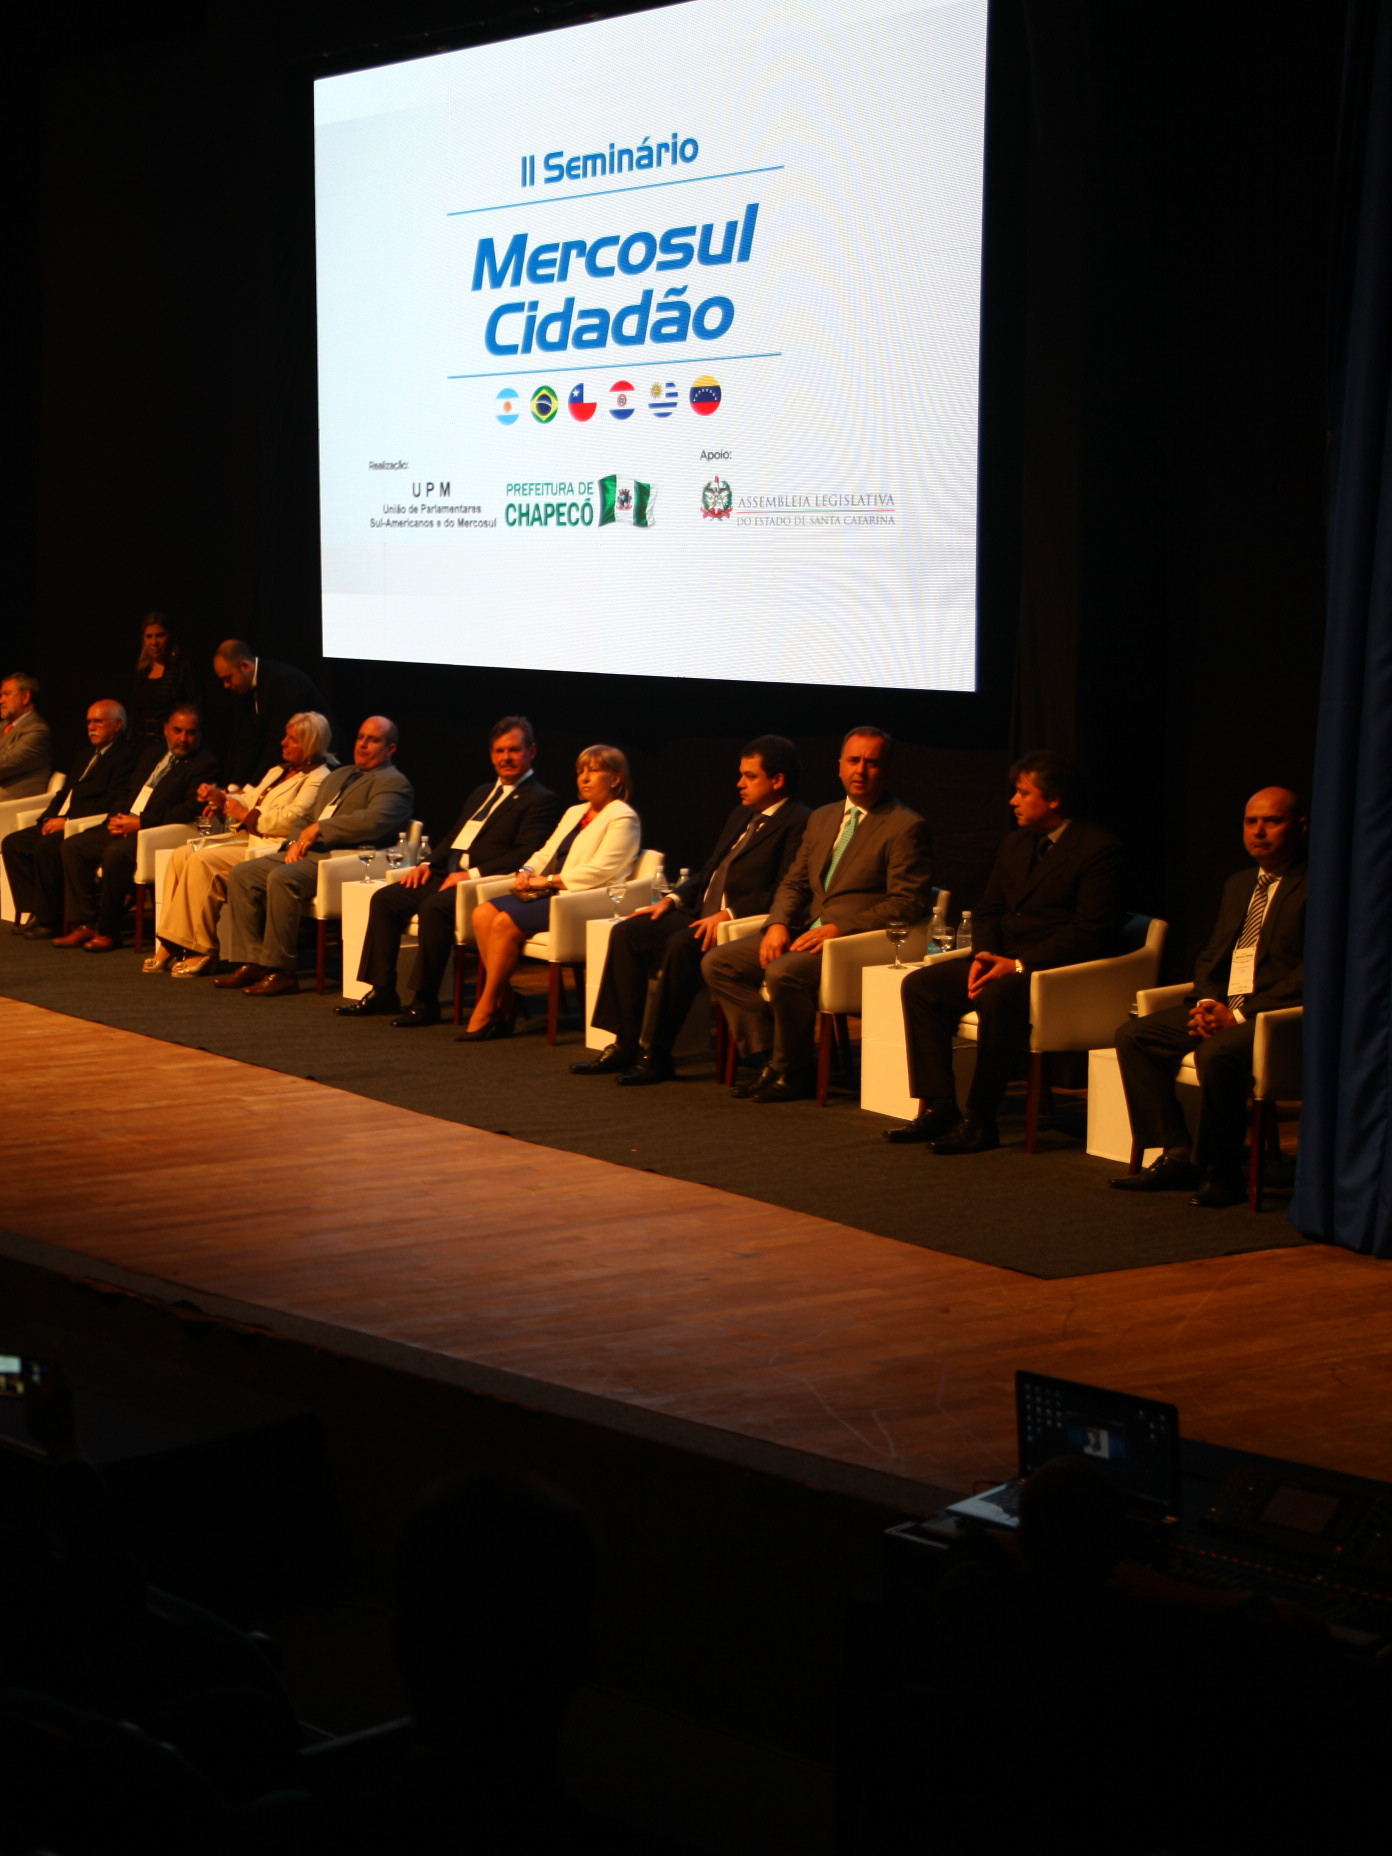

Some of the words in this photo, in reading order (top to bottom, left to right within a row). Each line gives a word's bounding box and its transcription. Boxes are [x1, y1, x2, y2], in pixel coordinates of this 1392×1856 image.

[521, 156, 535, 188] II
[544, 131, 699, 185] Seminário
[470, 203, 760, 292] Mercosul
[484, 284, 735, 357] Cidadão
[699, 449, 732, 462] Apoio:
[506, 482, 575, 497] PREFEITURA
[578, 481, 594, 496] DE
[738, 495, 811, 508] ASSEMBLEIA
[815, 494, 895, 507] LEGISLATIVA
[383, 504, 407, 514] União
[409, 504, 419, 514] de
[420, 504, 482, 514] Parlamentares
[504, 498, 594, 528] CHAPECÓ
[370, 518, 434, 528] Sul-Americanos
[436, 519, 442, 528] e
[444, 518, 455, 528] do
[457, 518, 497, 528] Mercosul
[736, 517, 751, 526] DO
[755, 516, 791, 526] ESTADO
[809, 516, 841, 526] SANTA
[843, 515, 895, 526] CATARINA
